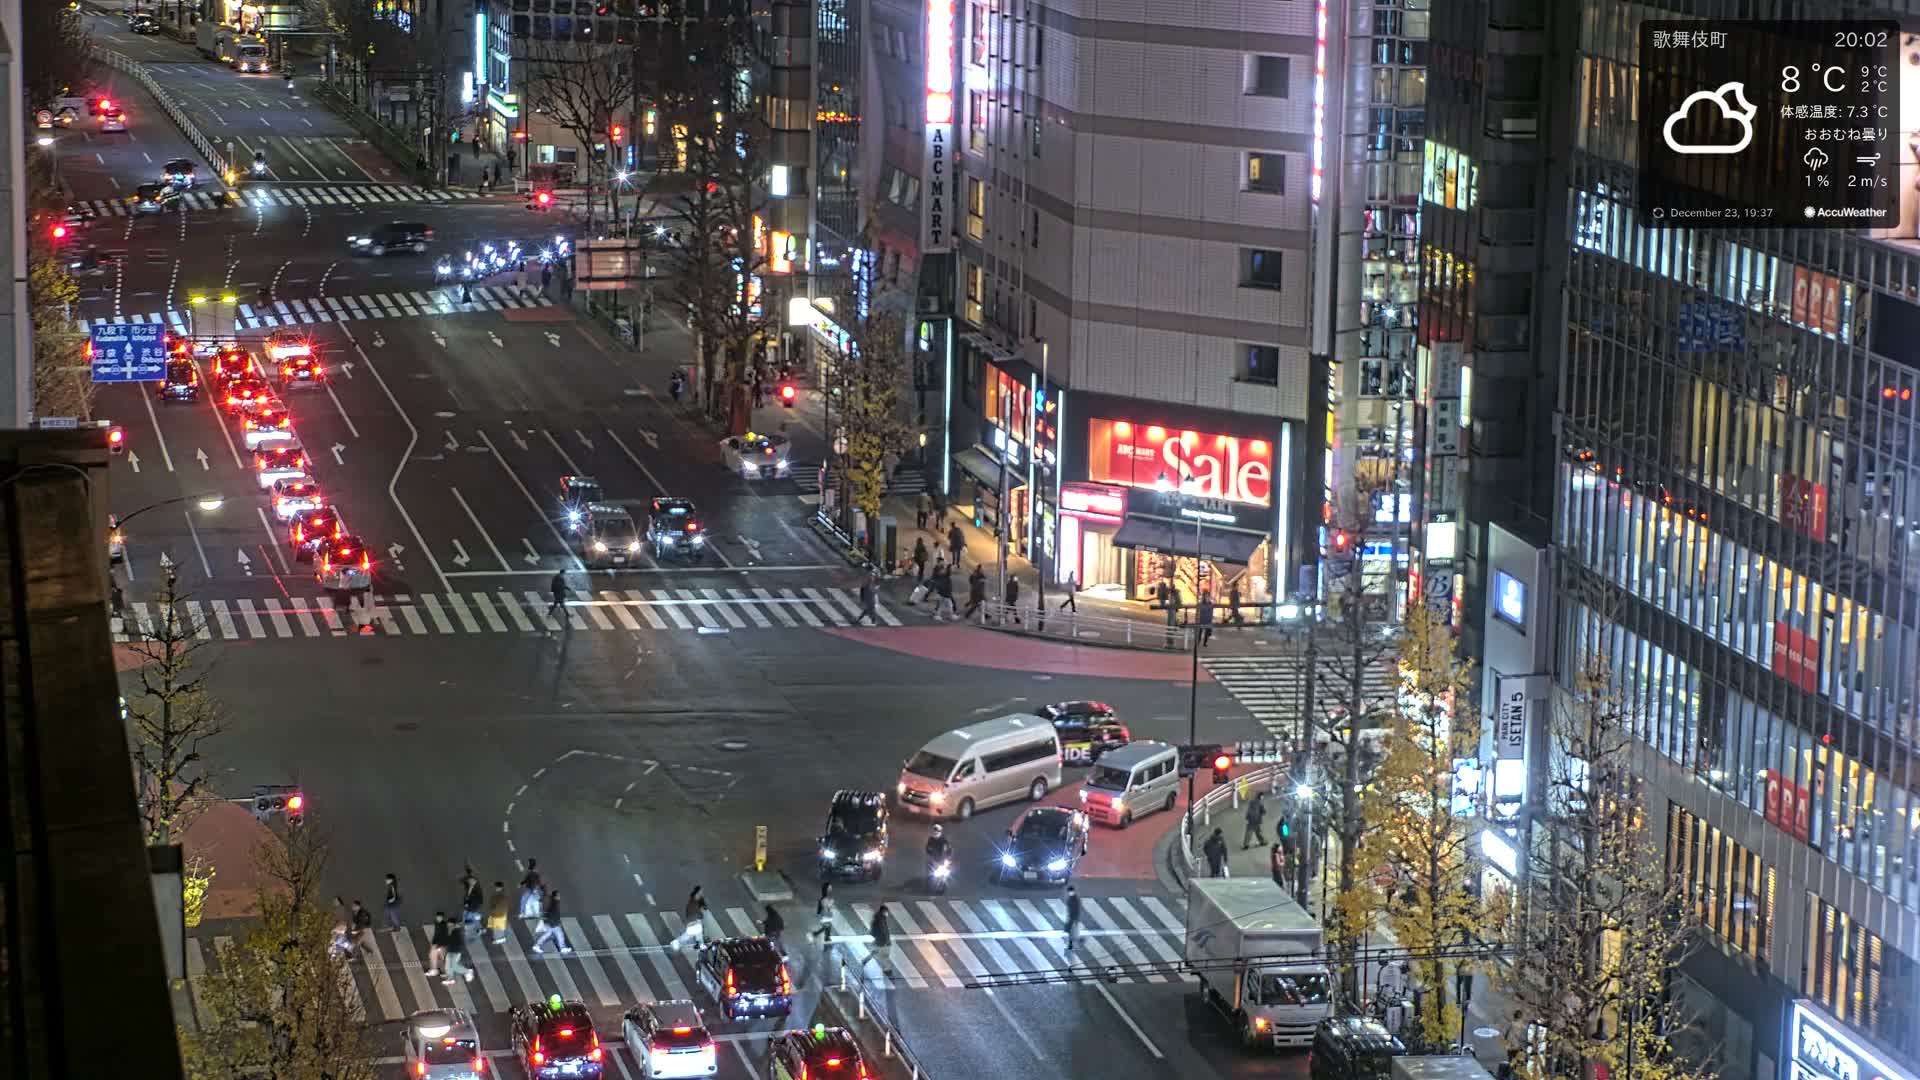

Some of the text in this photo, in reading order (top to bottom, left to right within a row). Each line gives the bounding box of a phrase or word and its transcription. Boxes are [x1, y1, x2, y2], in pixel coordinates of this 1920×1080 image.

[98, 326, 126, 335] 九段下
[1163, 436, 1269, 501] Sale
[1501, 703, 1510, 720] CITY
[1509, 692, 1524, 747] ISETAN 5
